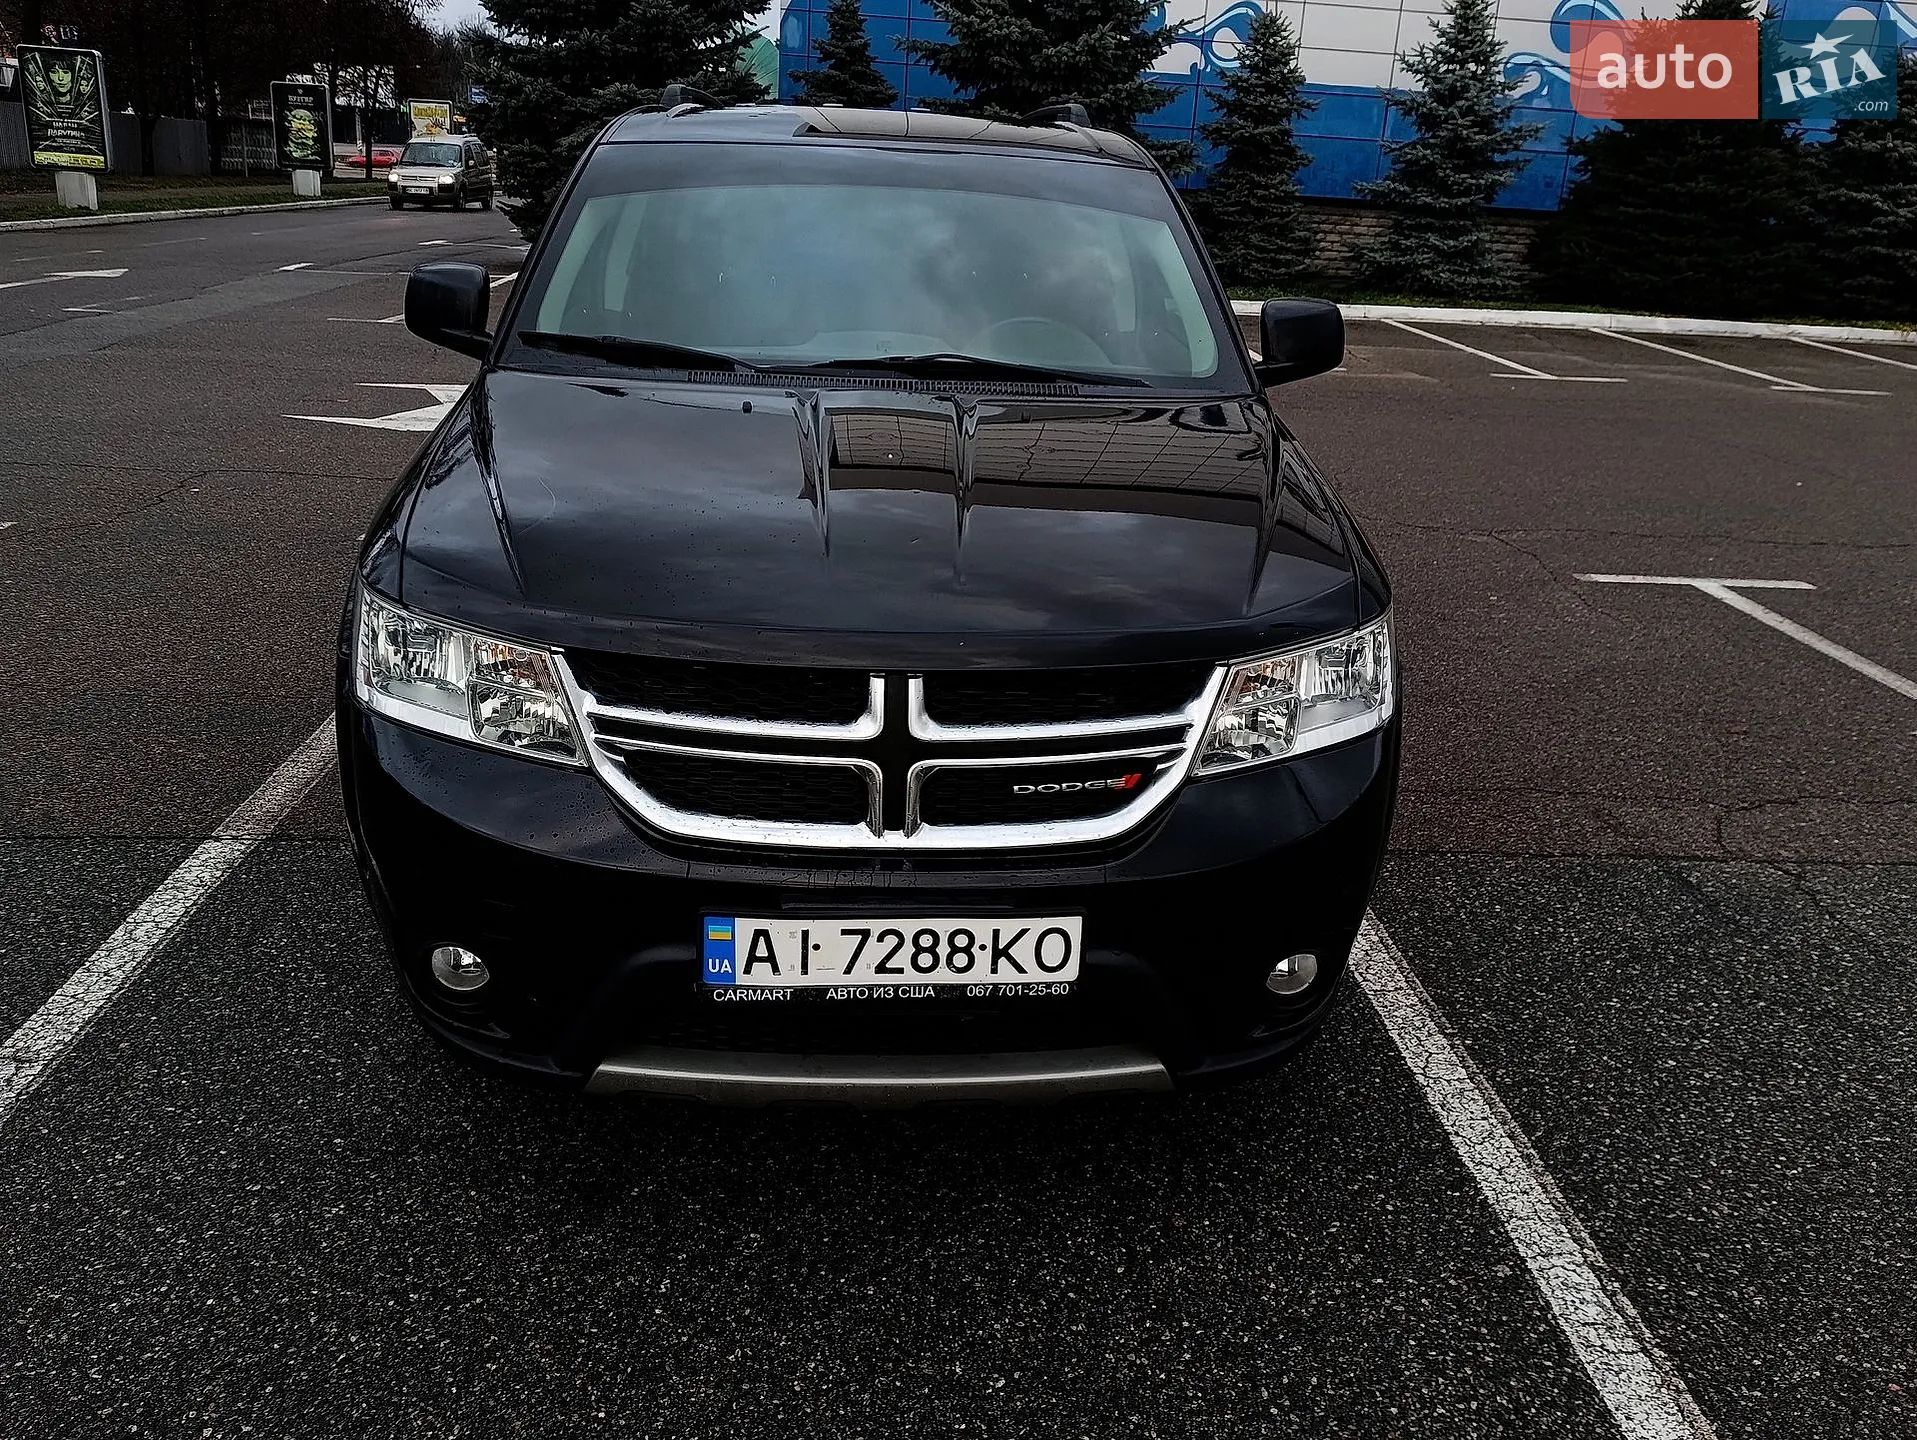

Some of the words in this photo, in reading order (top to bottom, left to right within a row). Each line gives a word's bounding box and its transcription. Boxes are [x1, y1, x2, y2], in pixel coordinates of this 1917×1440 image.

[1013, 777, 1126, 794] DODGE
[708, 958, 733, 974] UA
[713, 989, 794, 1001] CARMART
[826, 987, 869, 1000] АВТО
[873, 986, 894, 999] ИЗ
[898, 986, 936, 998] США
[967, 985, 991, 997] 067
[998, 983, 1069, 996] 701-25-60
